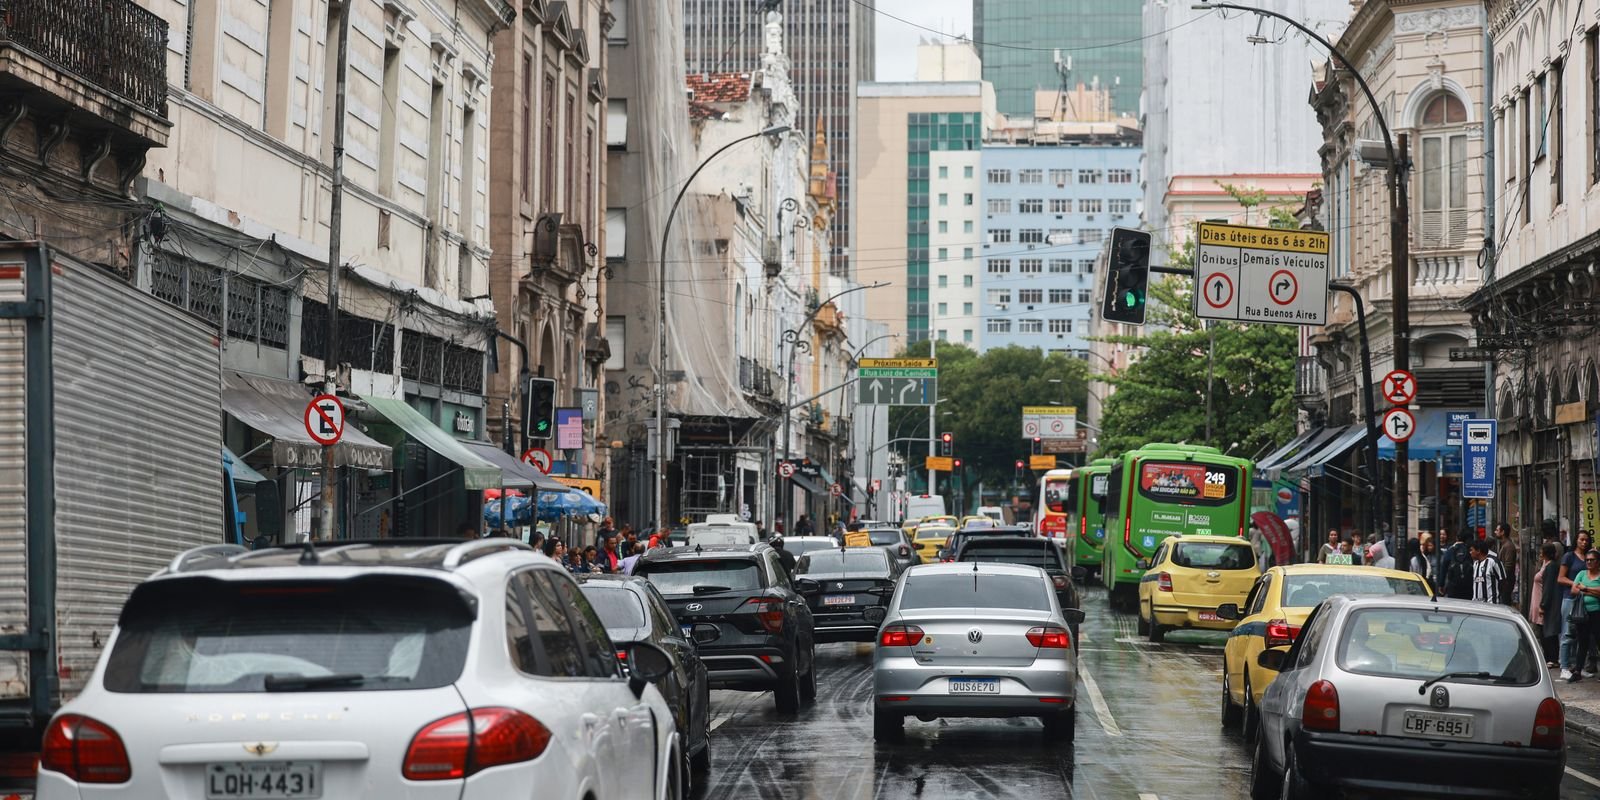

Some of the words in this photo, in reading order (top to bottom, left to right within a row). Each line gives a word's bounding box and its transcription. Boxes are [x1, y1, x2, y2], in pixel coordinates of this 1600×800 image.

[1202, 229, 1226, 240] Dias
[1230, 230, 1257, 244] úteis
[1260, 234, 1279, 246] das
[1282, 236, 1289, 246] 6
[1309, 238, 1325, 249] 21h
[1202, 252, 1238, 265] Ônibus
[1243, 253, 1280, 266] Demais
[1283, 256, 1325, 269] Veículos
[1246, 306, 1260, 316] Rua
[1264, 308, 1293, 318] Buenos
[1296, 309, 1317, 320] Aires
[1205, 472, 1225, 484] 249
[1327, 554, 1352, 564] TAXI
